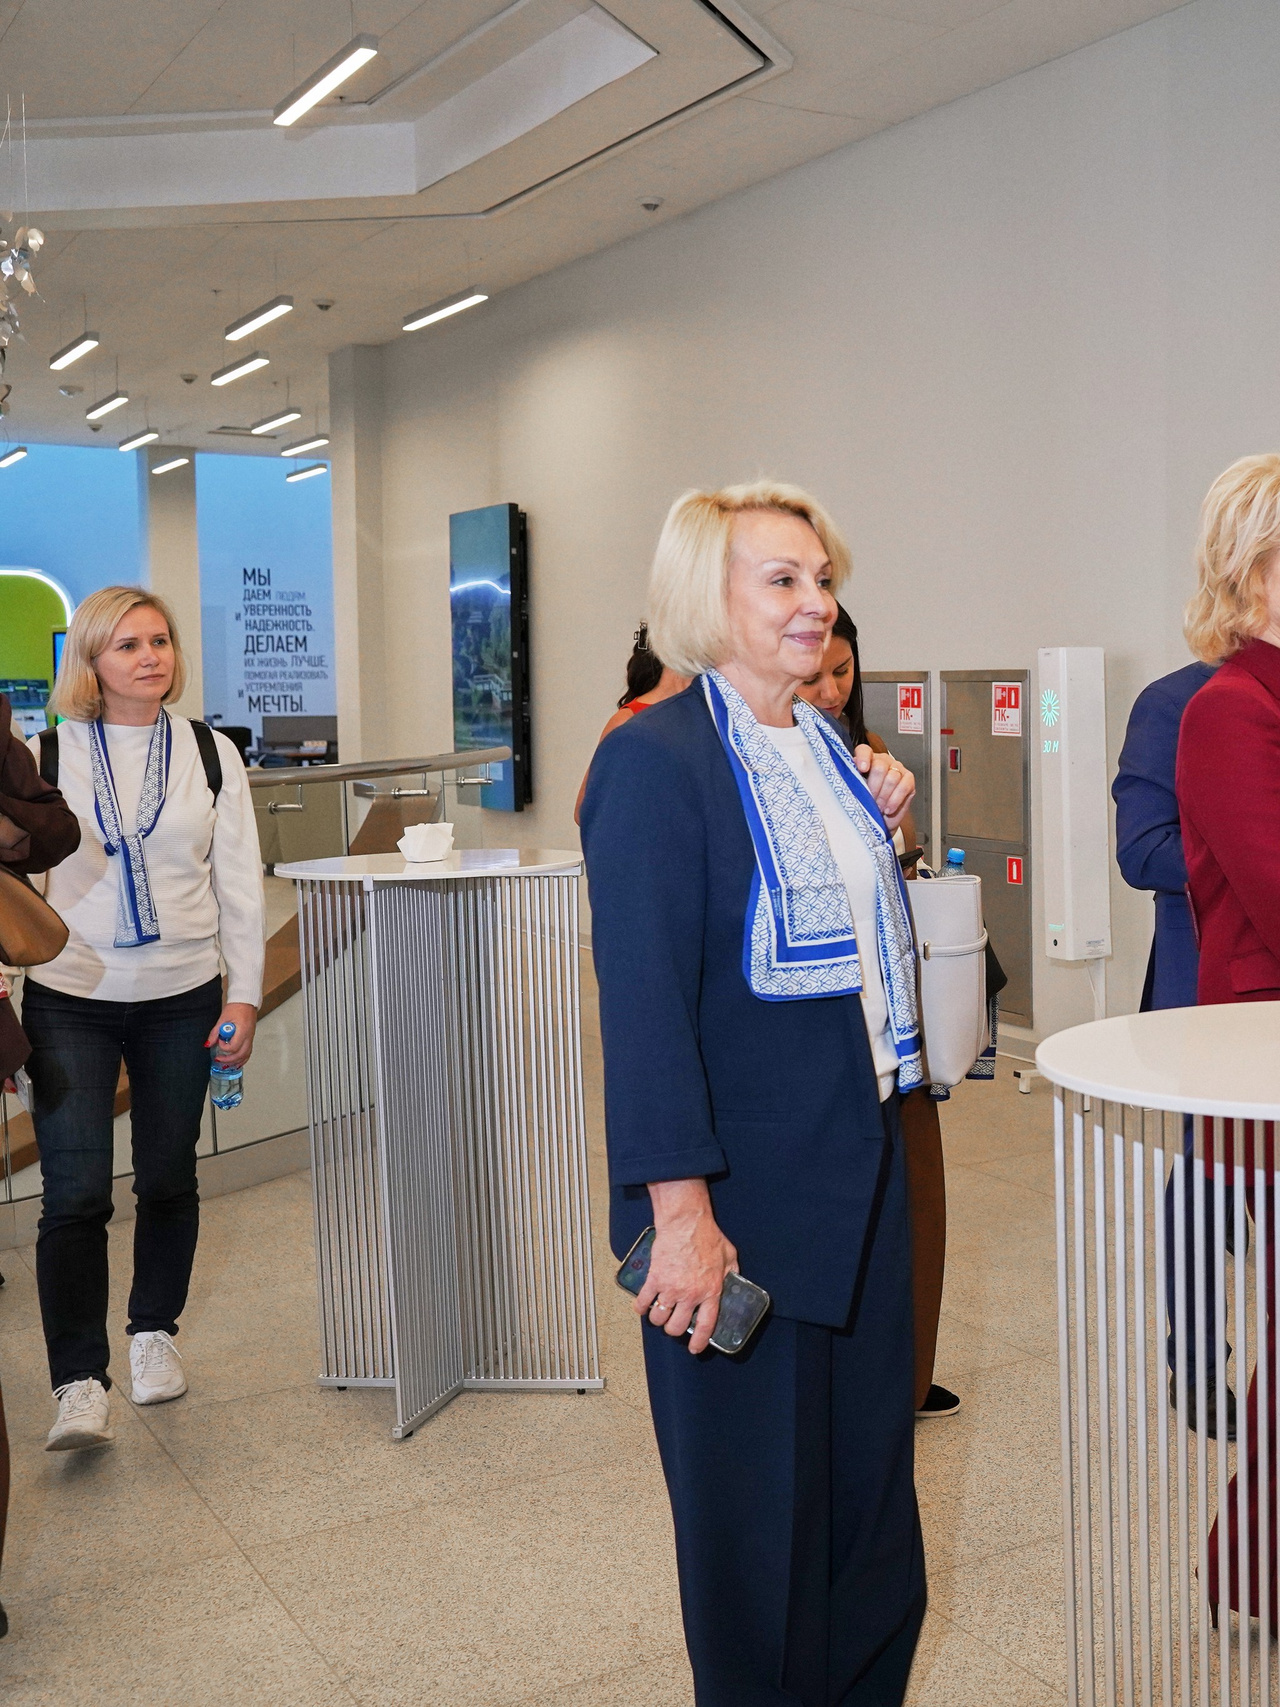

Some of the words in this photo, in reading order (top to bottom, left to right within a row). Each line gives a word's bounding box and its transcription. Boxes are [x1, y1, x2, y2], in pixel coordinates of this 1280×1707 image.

[243, 567, 271, 586] МЫ
[243, 588, 271, 601] ДАЕМ
[243, 604, 312, 617] УВЕРЕННОСТЬ
[244, 635, 308, 655] ДЕЛАЕМ
[244, 657, 255, 668] ИХ
[257, 657, 288, 668] ЖИЗНЬ
[245, 682, 304, 693] УСТРЕМЛЕНИЯ
[248, 695, 307, 713] МЕЧТЫ.
